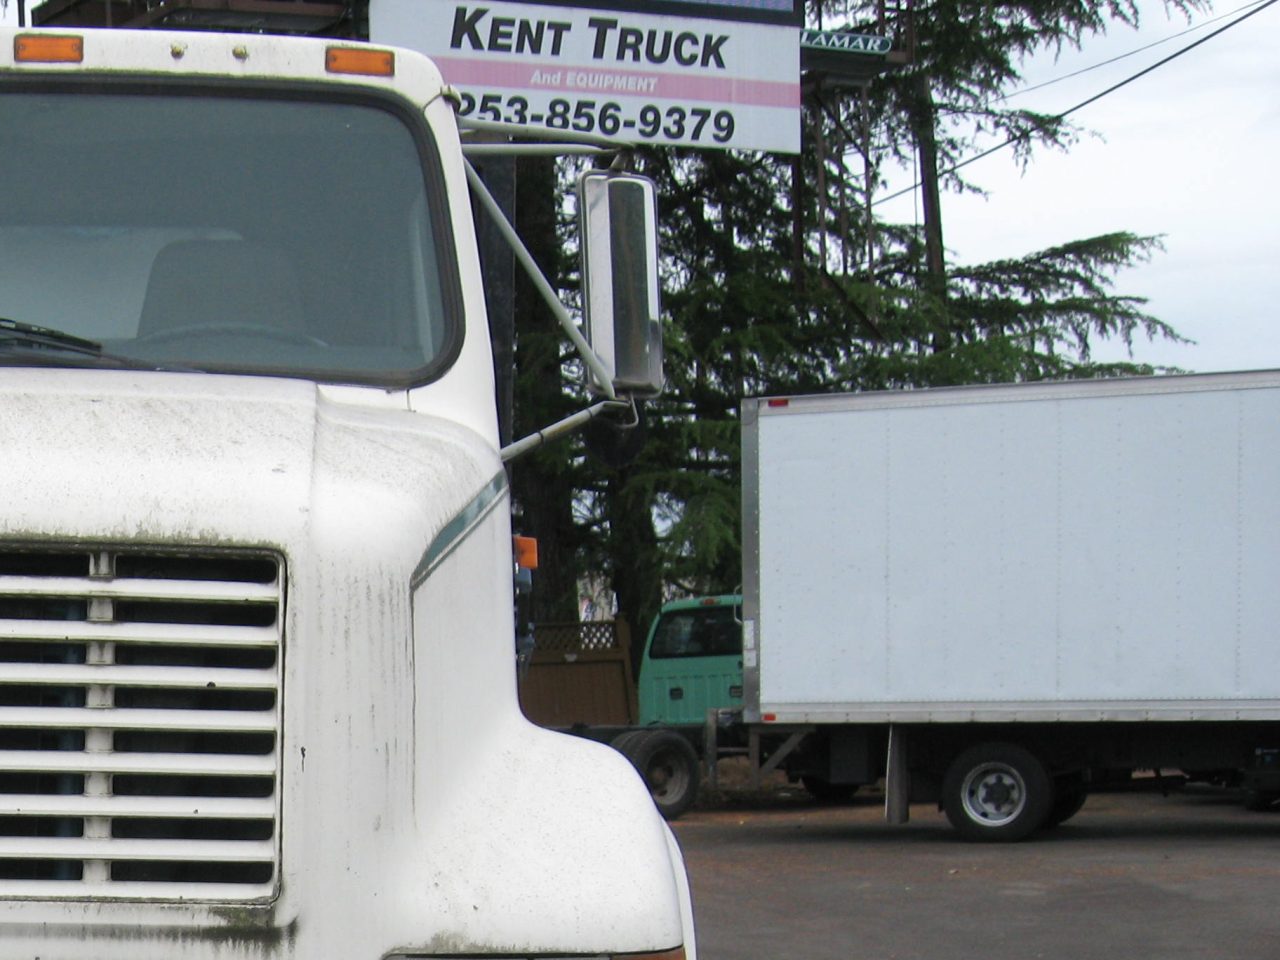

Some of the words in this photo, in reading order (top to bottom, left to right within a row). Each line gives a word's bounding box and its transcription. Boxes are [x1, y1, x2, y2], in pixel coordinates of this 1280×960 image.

[450, 6, 572, 57] KENT
[587, 17, 731, 69] TRUCK
[800, 31, 882, 51] LAMAR
[530, 70, 562, 87] And
[566, 72, 658, 93] EQUIPMENT
